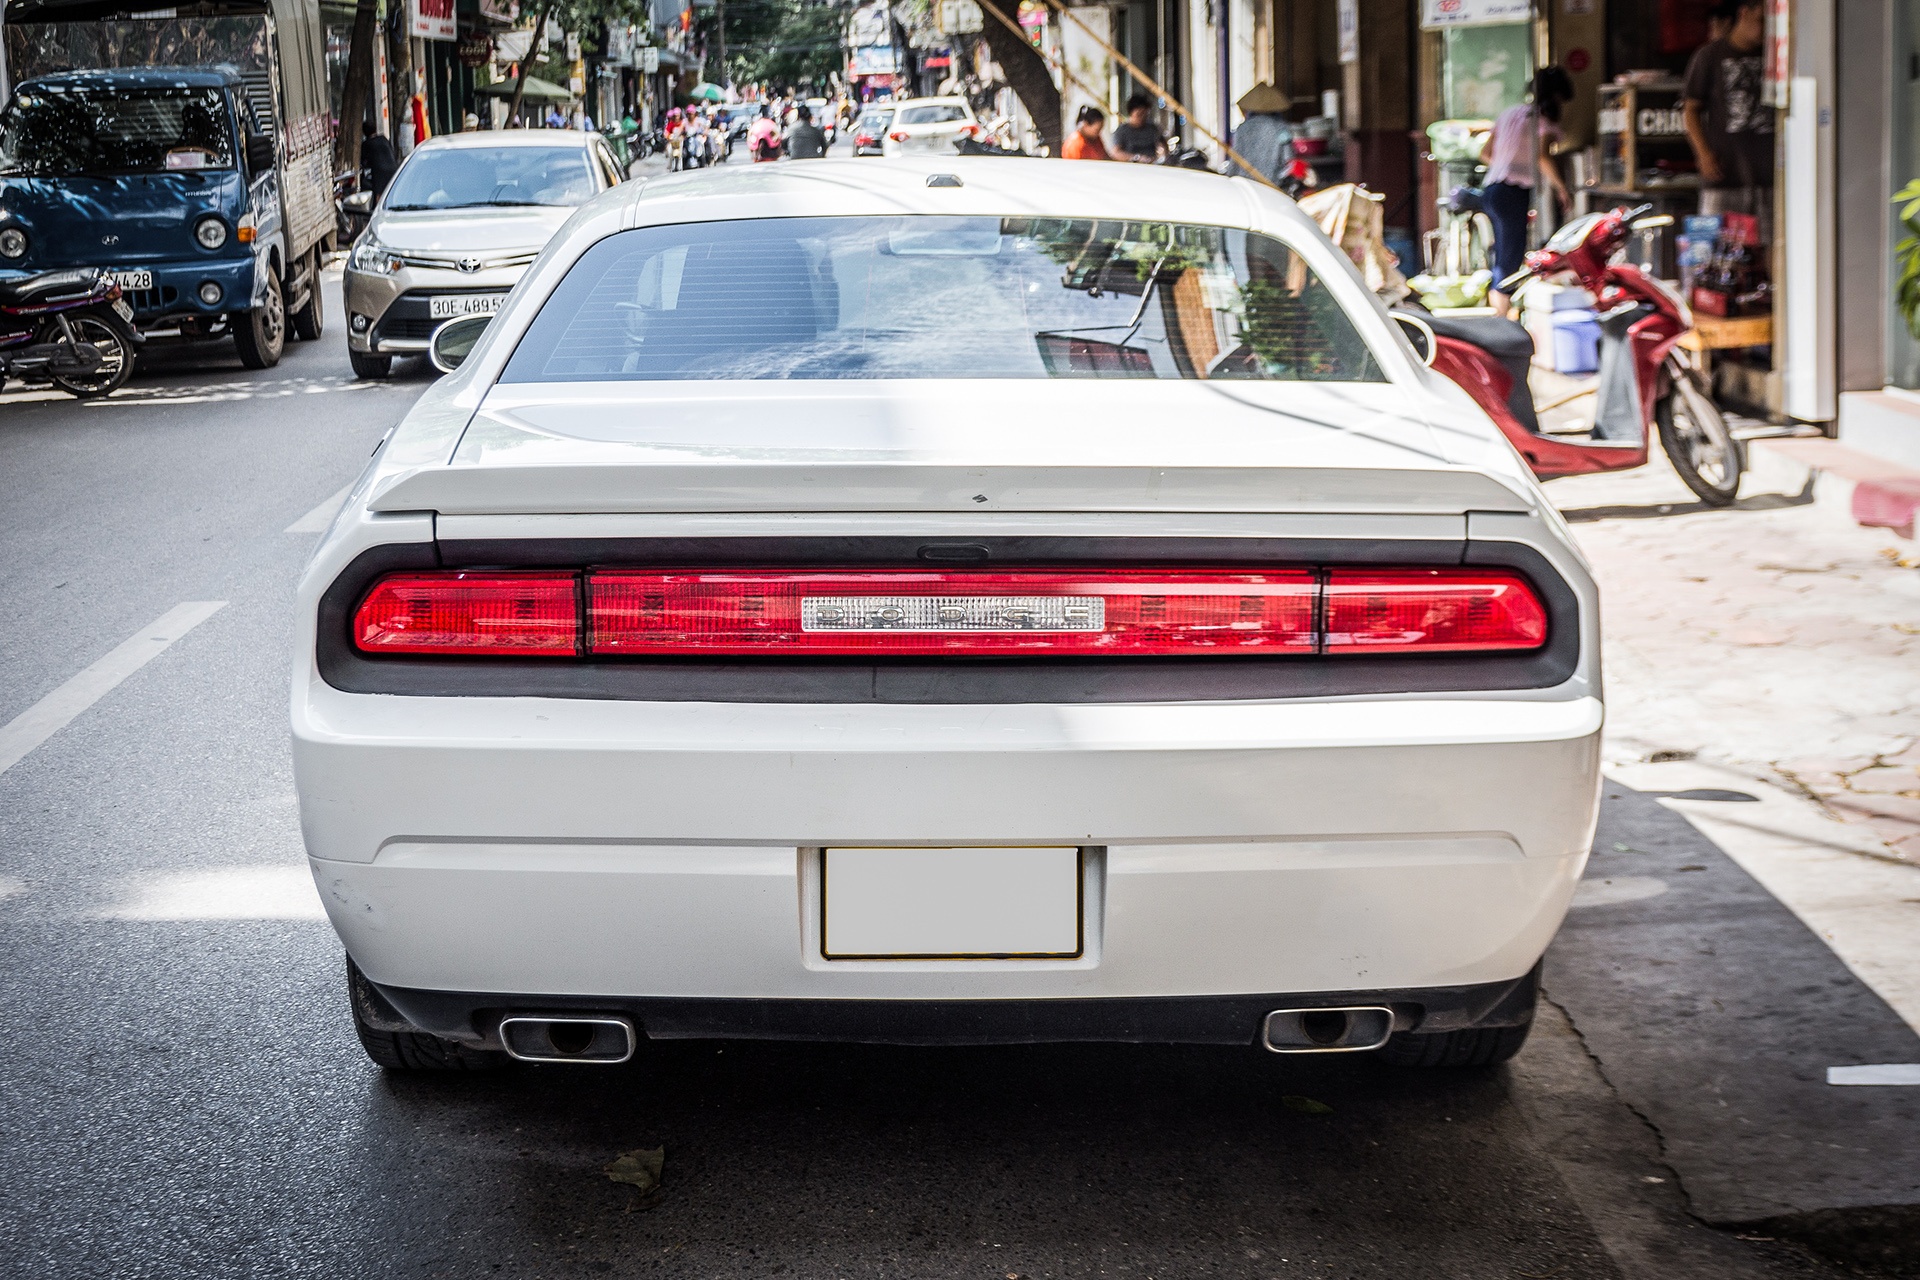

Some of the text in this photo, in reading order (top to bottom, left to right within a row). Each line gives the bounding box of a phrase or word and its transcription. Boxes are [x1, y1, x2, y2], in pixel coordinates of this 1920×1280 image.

[1638, 101, 1686, 135] CHÁ
[113, 272, 151, 289] 44.28
[816, 605, 1090, 622] DODGE
